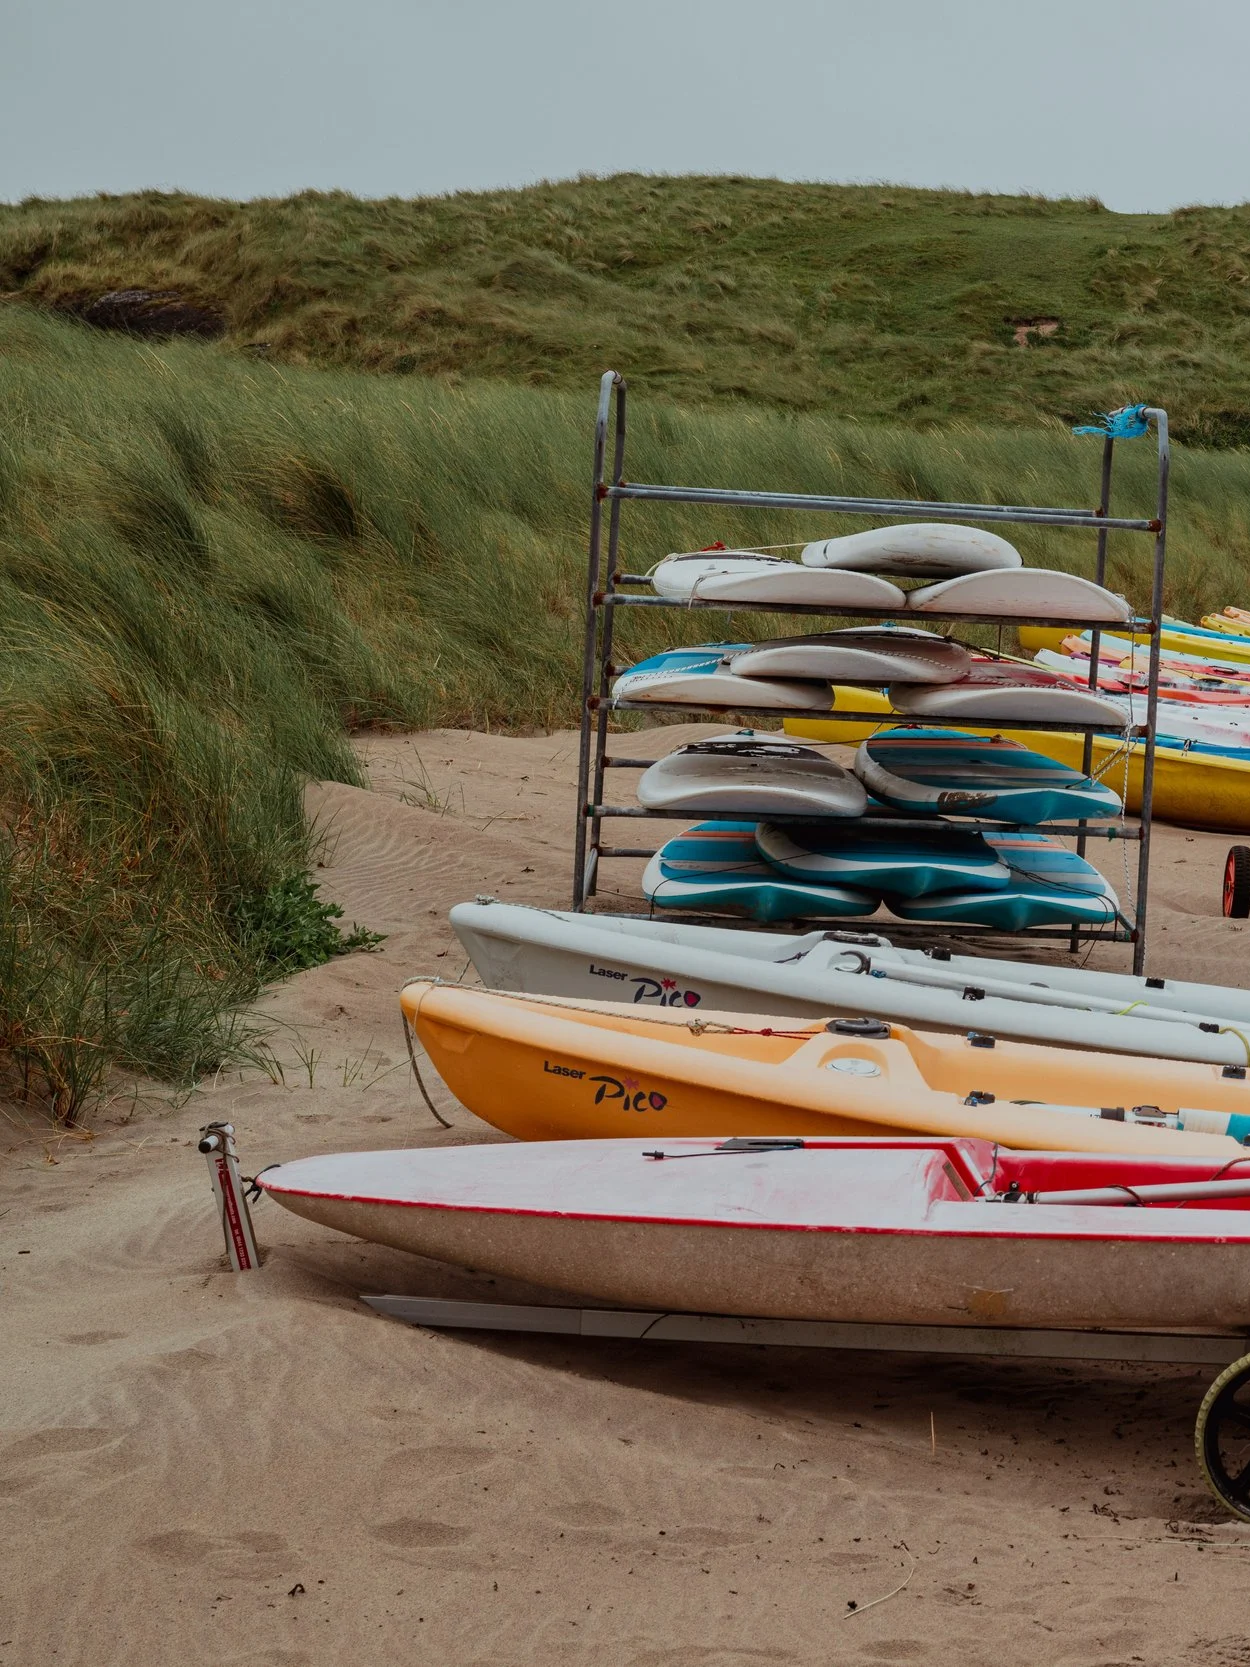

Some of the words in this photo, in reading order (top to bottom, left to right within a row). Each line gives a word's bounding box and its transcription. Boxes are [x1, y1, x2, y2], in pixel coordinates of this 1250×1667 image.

[589, 964, 628, 981] Laser
[629, 977, 701, 1008] Pico
[543, 1060, 586, 1080] Laser
[588, 1075, 668, 1112] Pico
